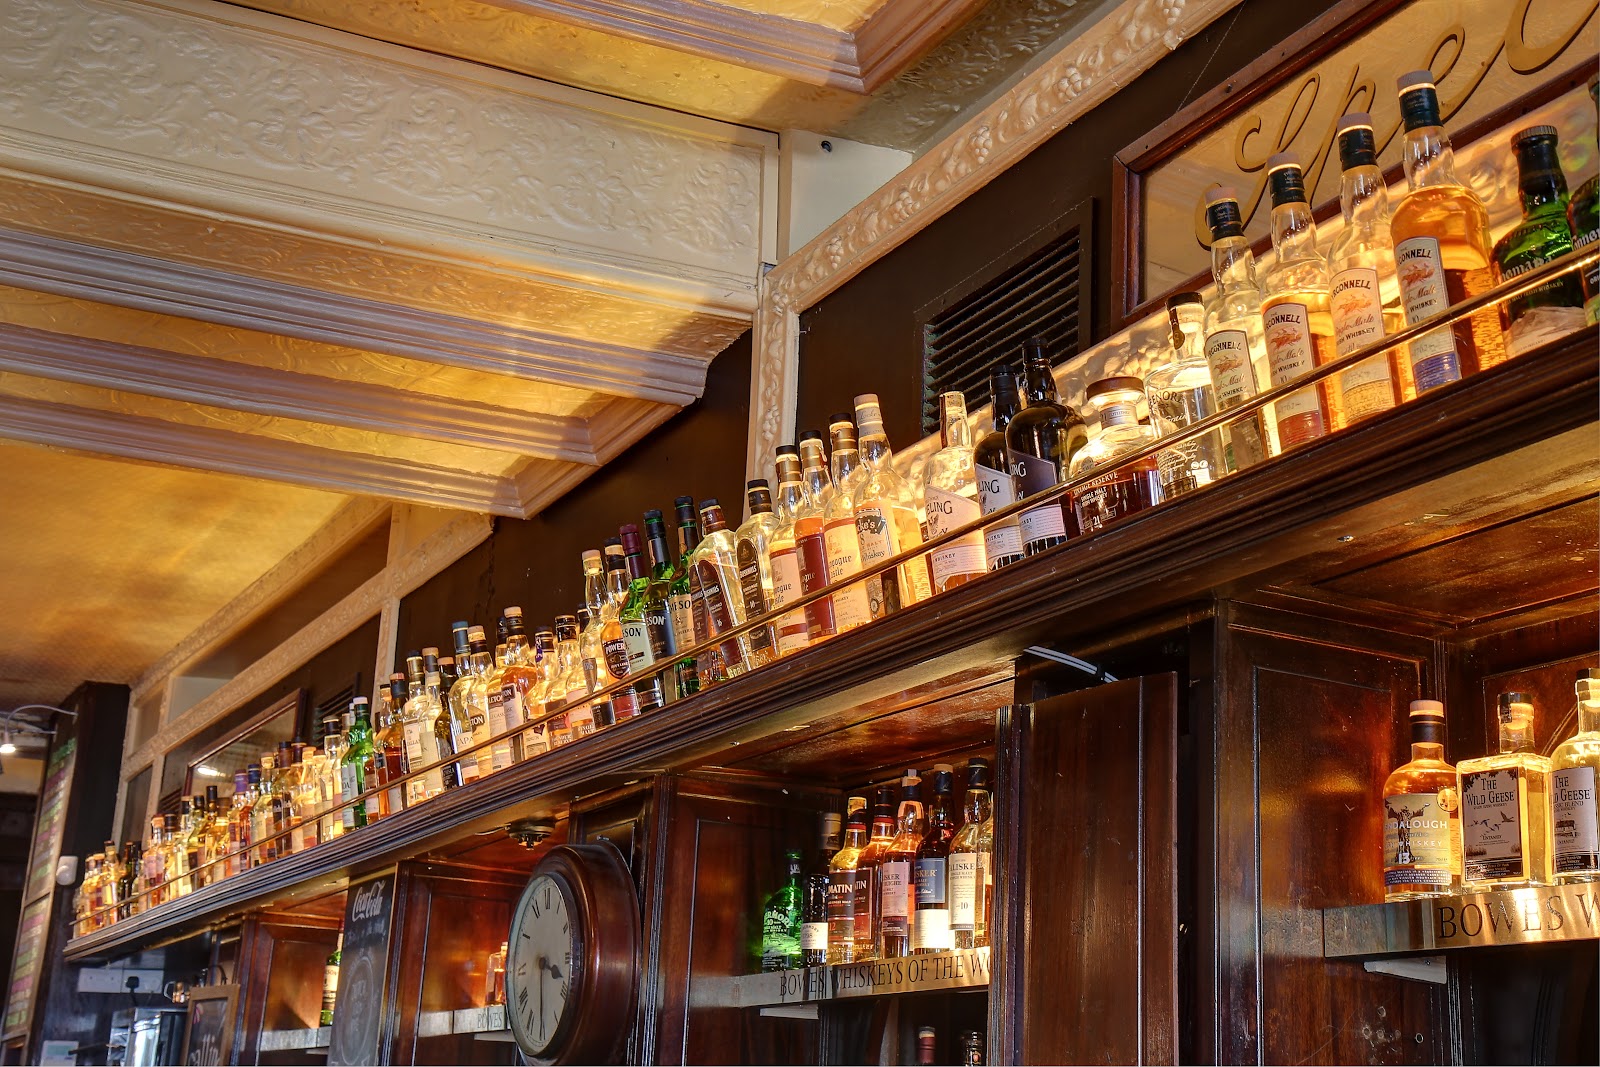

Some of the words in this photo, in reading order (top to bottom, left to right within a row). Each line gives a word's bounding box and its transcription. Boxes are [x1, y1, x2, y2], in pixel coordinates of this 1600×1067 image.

[1409, 299, 1438, 313] WHISKEY
[1345, 327, 1375, 340] WHISKEY
[1481, 777, 1497, 790] THE
[1554, 775, 1569, 788] THE
[1466, 793, 1486, 806] WILD
[1488, 791, 1515, 804] GEESE
[1560, 788, 1591, 802] GEESE
[1398, 852, 1411, 865] 13
[1437, 895, 1564, 939] BOWES
[829, 922, 836, 931] 12
[779, 970, 825, 996] BOWES
[829, 960, 903, 990] WHISKEYS
[908, 957, 929, 983] OF
[933, 954, 964, 980] THE
